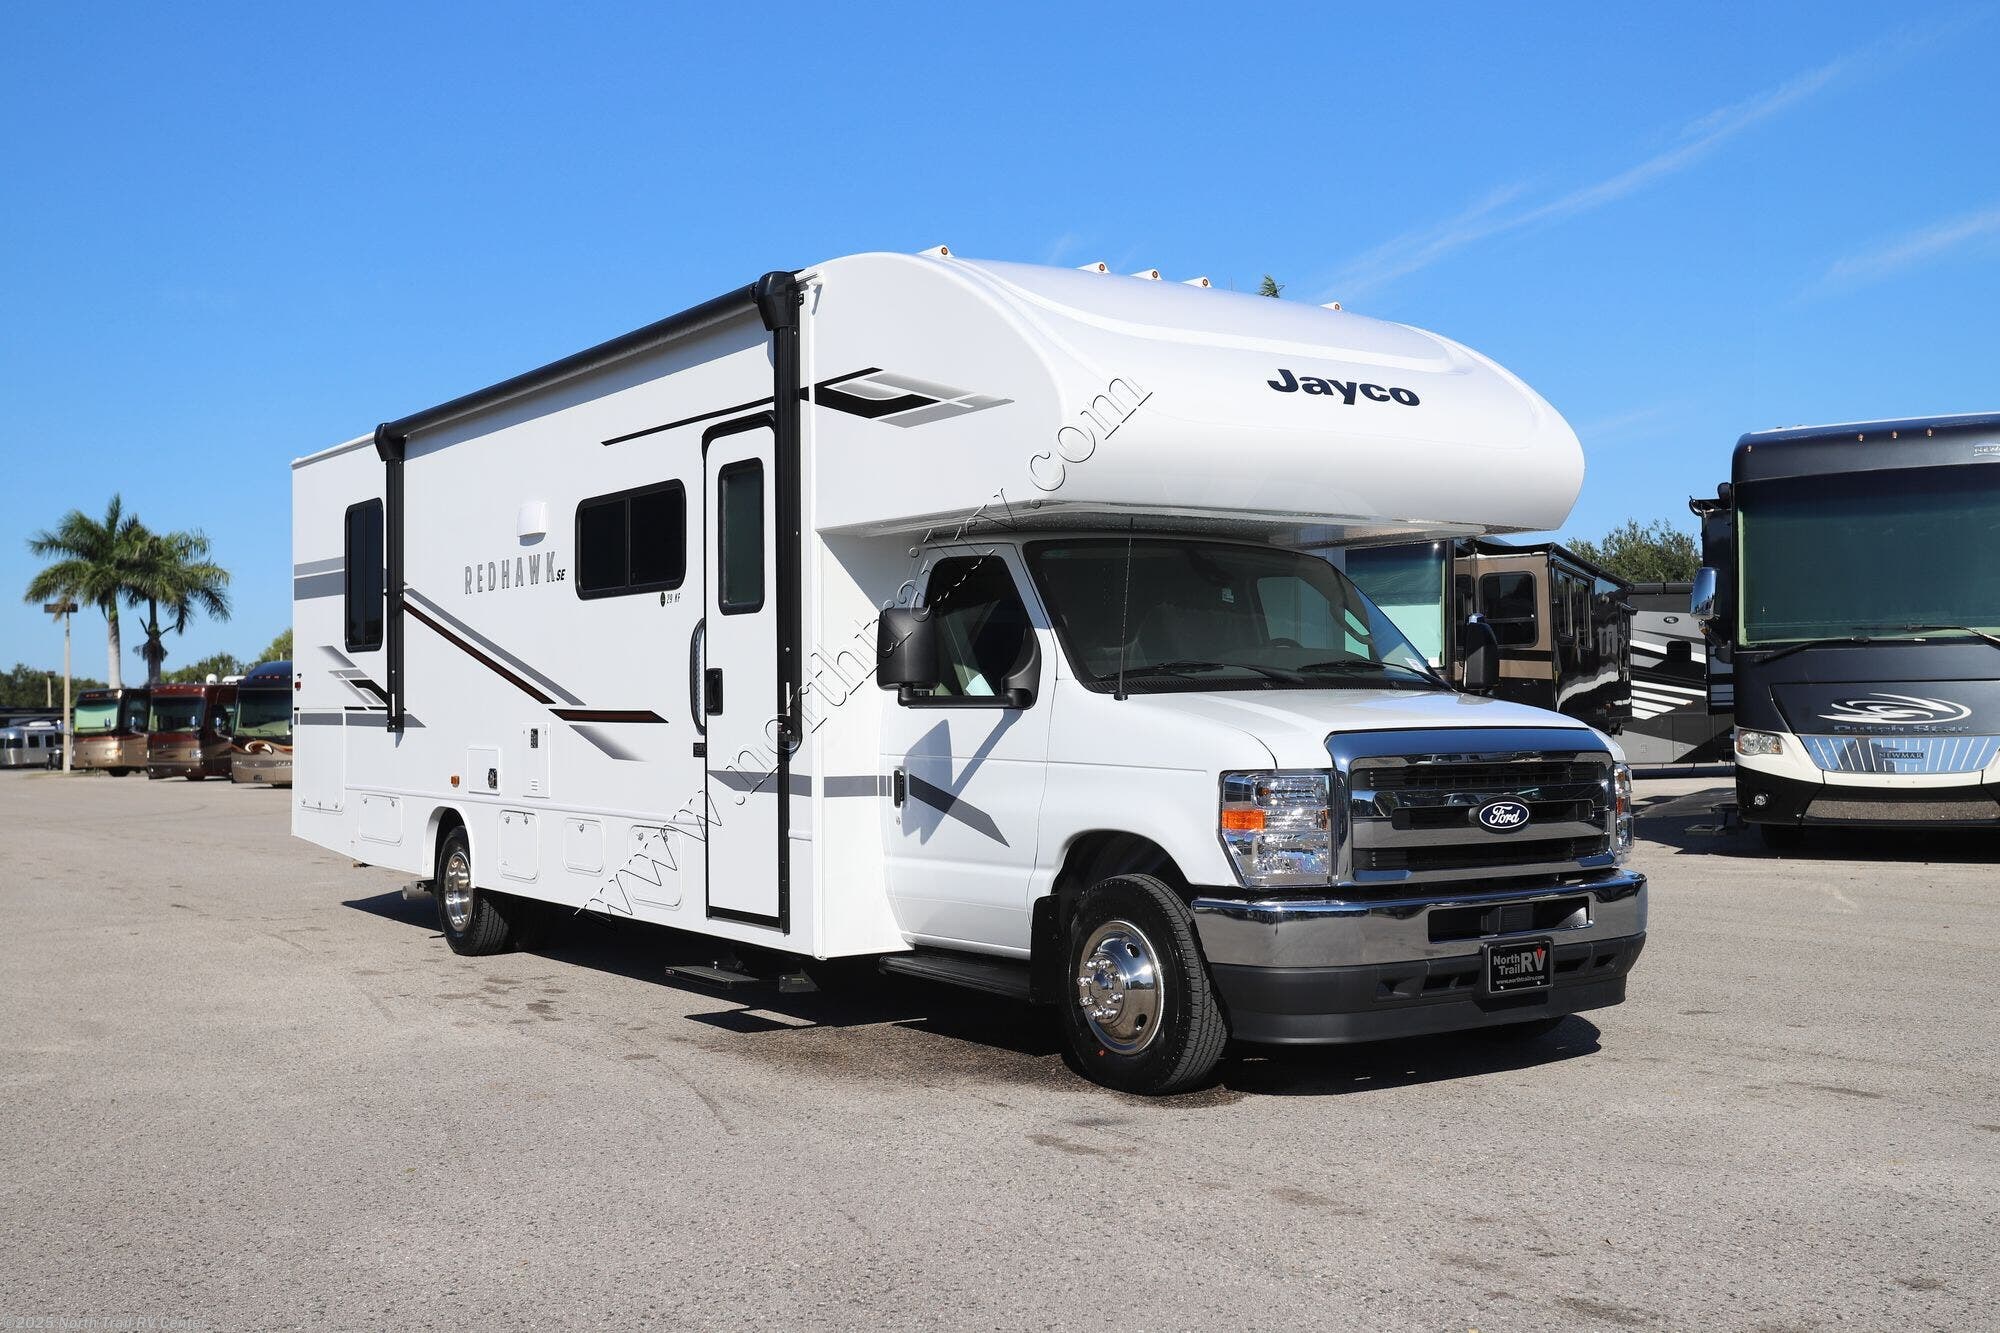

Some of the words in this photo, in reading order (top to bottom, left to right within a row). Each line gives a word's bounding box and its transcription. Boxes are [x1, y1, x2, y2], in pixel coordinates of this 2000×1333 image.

[1266, 368, 1420, 407] Jayco
[464, 551, 555, 595] REDHAWK
[556, 569, 566, 581] SE
[1880, 752, 1924, 760] NEWMAR
[1489, 805, 1521, 824] Ford
[1493, 953, 1520, 966] North
[1520, 949, 1547, 973] RV
[1498, 963, 1520, 976] Trail
